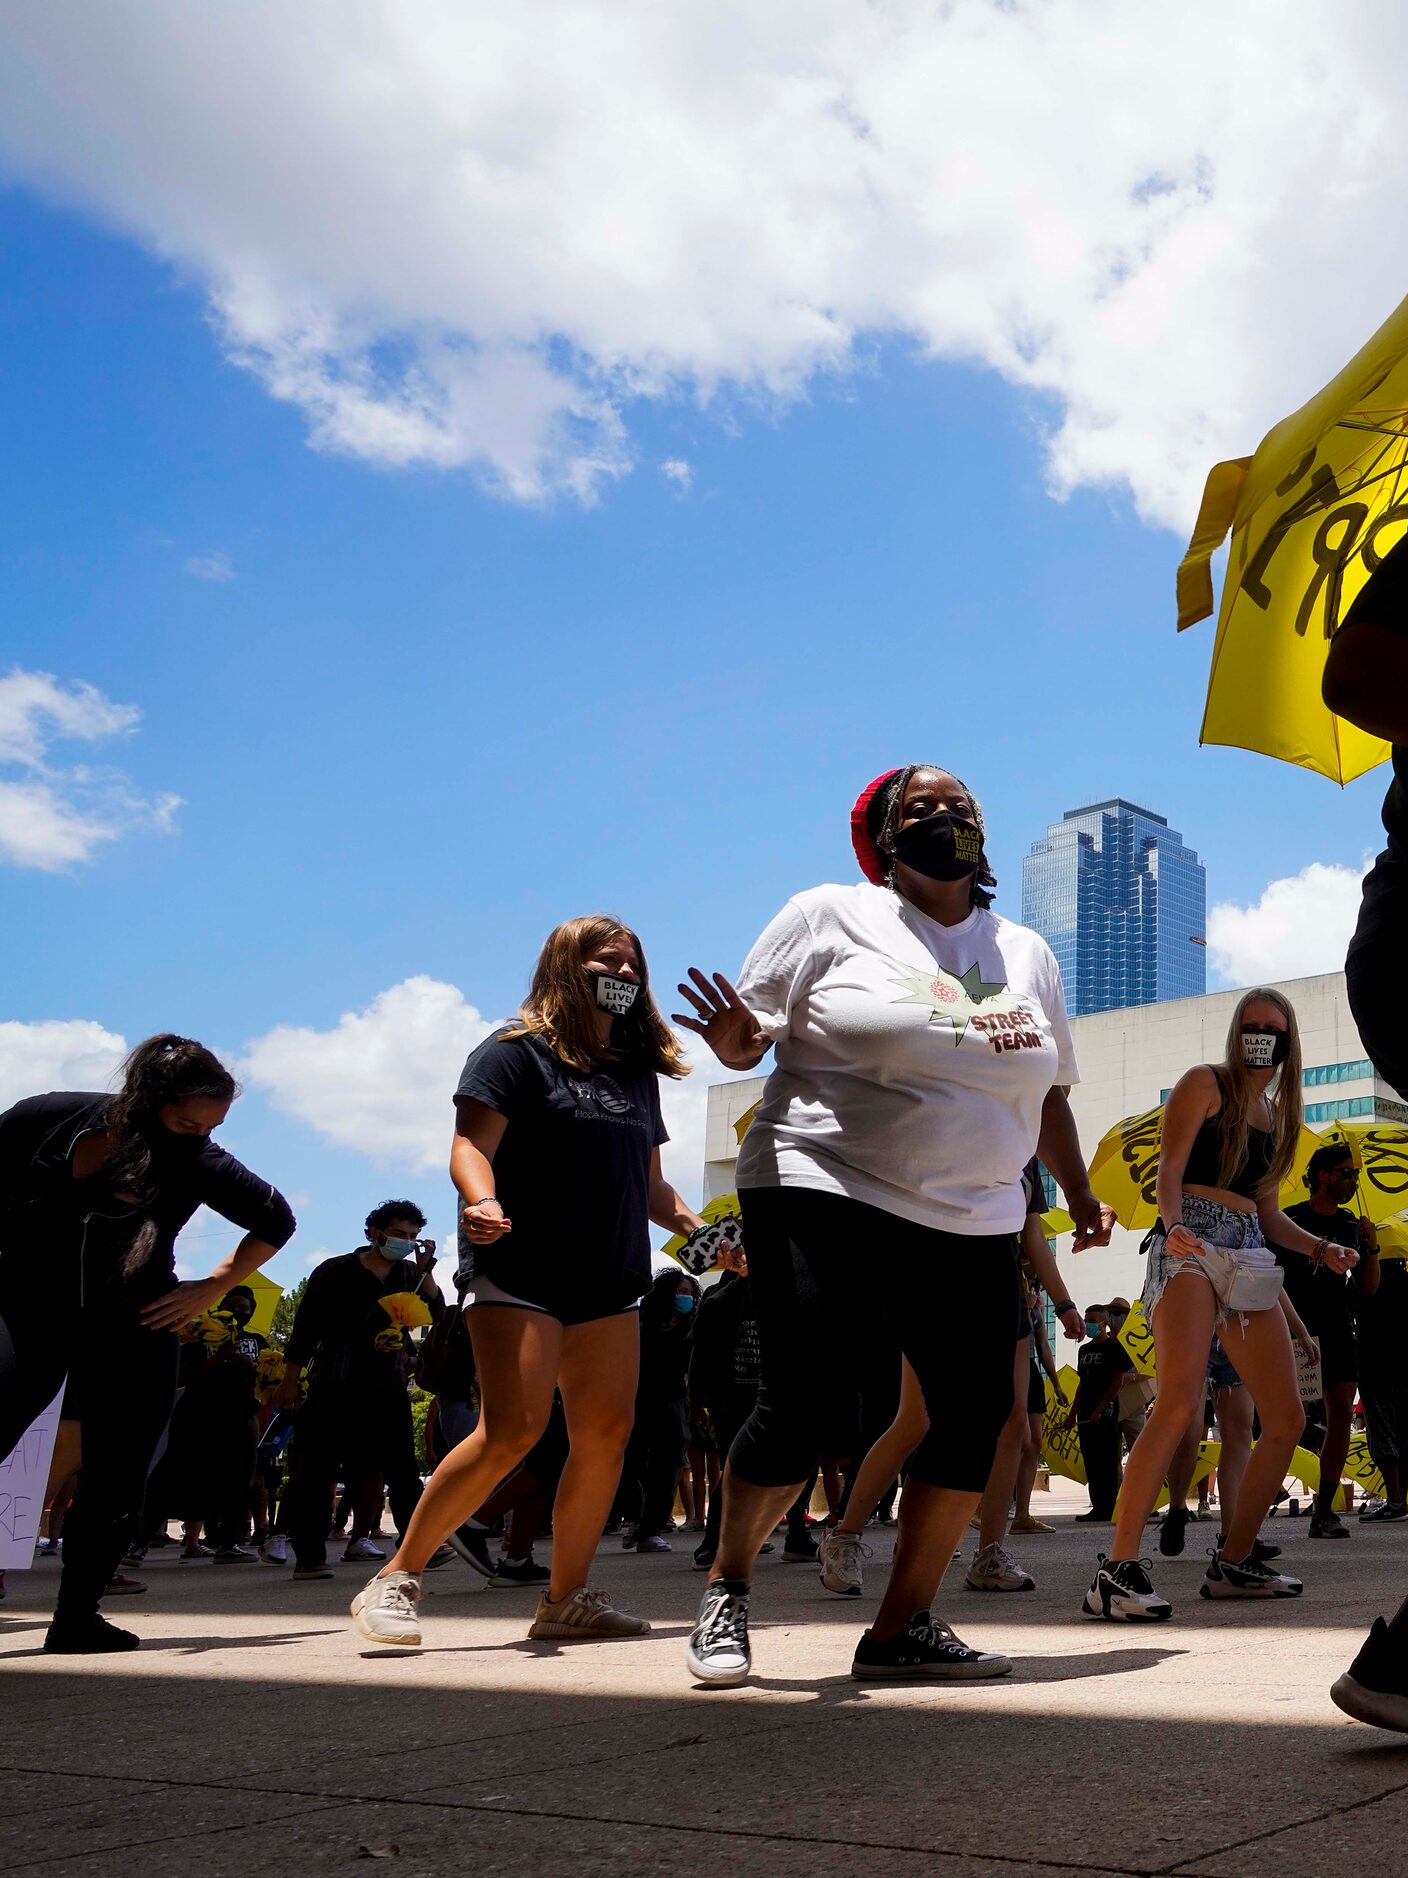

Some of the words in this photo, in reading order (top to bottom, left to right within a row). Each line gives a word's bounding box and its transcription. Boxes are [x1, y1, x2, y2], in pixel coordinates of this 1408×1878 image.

[952, 826, 982, 842] BLACK
[956, 837, 981, 853] LIVES
[604, 981, 636, 995] BLACK
[970, 1010, 1034, 1032] STREET
[988, 1031, 1041, 1054] TEAM
[1244, 1038, 1272, 1046] BLACK
[1247, 1047, 1268, 1055] LIVES
[574, 1109, 600, 1120] Hope
[601, 1112, 625, 1124] Knows
[1081, 1352, 1102, 1365] HOPE
